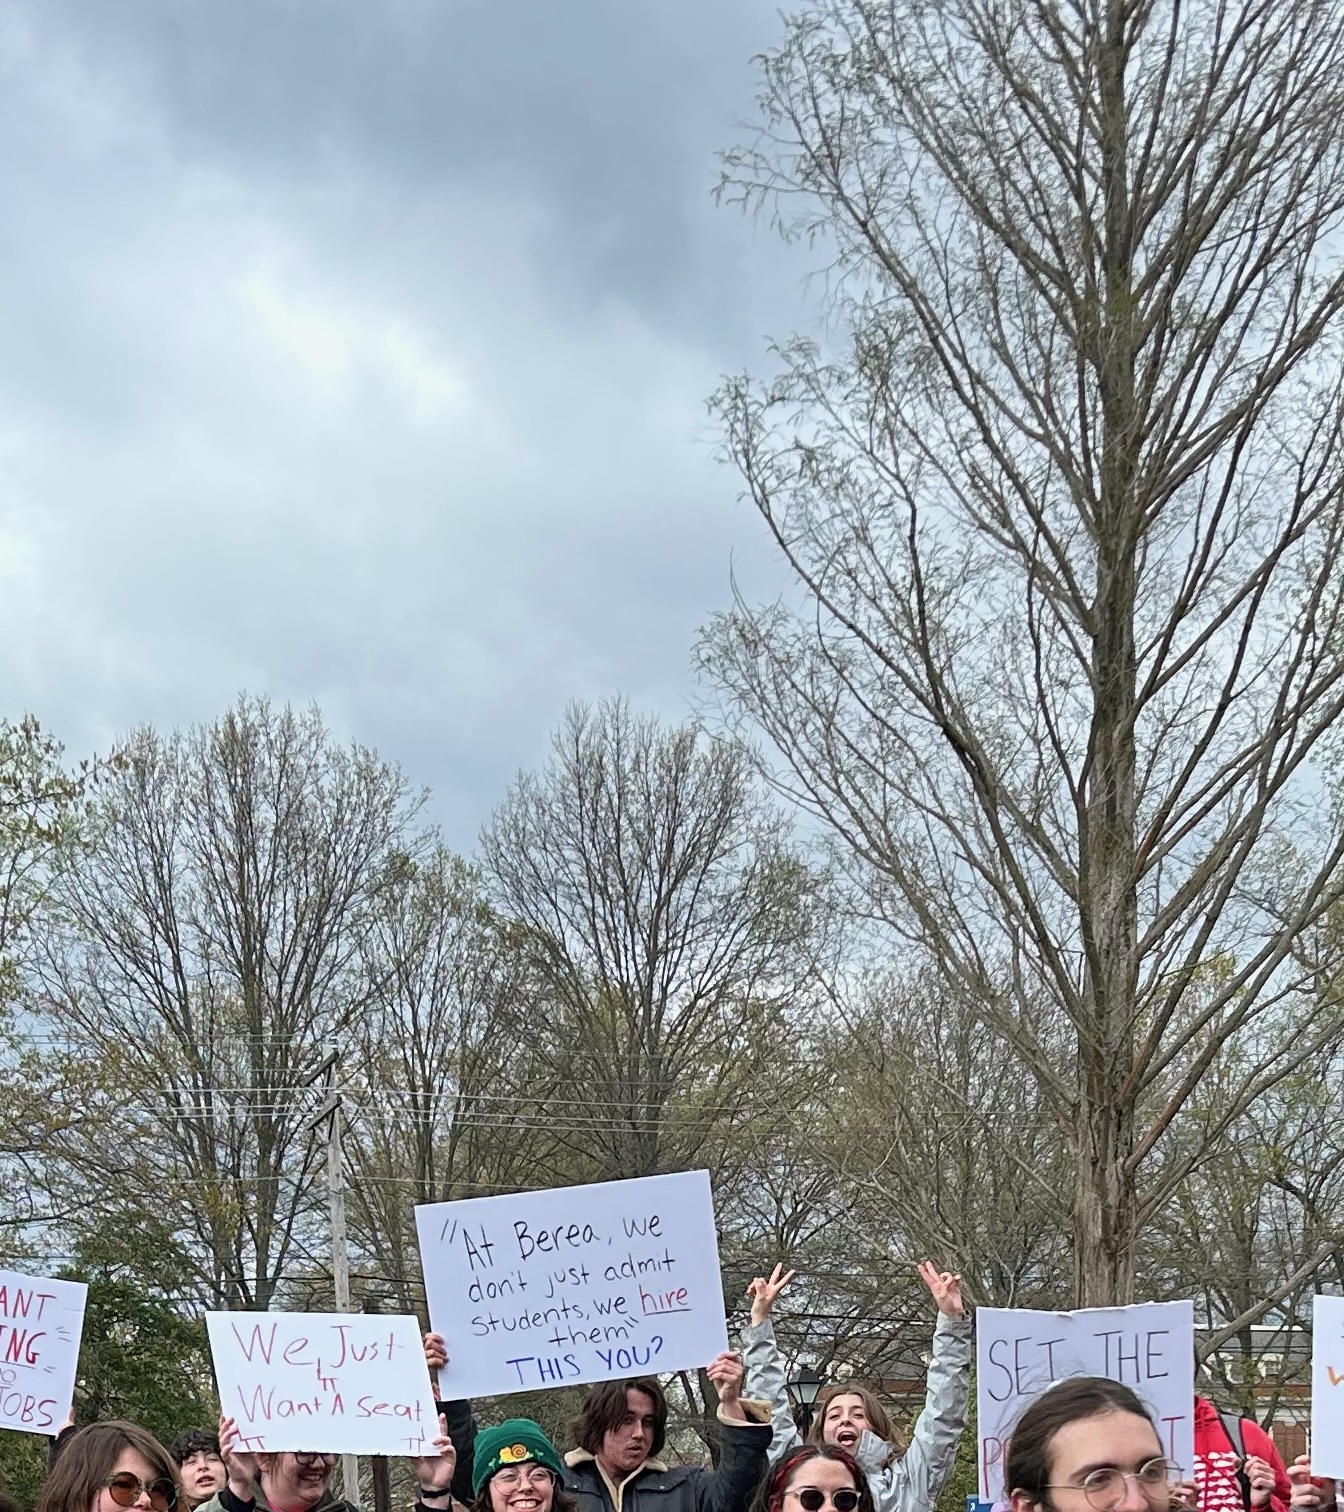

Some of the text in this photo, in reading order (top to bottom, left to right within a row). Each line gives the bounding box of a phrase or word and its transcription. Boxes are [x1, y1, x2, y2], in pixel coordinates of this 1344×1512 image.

[513, 1219, 613, 1262] Berea,
[624, 1212, 662, 1238] we
[468, 1247, 678, 1304] don't just admit
[592, 1295, 628, 1316] we
[638, 1283, 691, 1315] hire
[231, 1321, 405, 1370] We Just
[506, 1335, 665, 1386] THIS YOU?
[987, 1329, 1170, 1402] SET THE
[237, 1384, 323, 1422] Want
[330, 1392, 345, 1416] A
